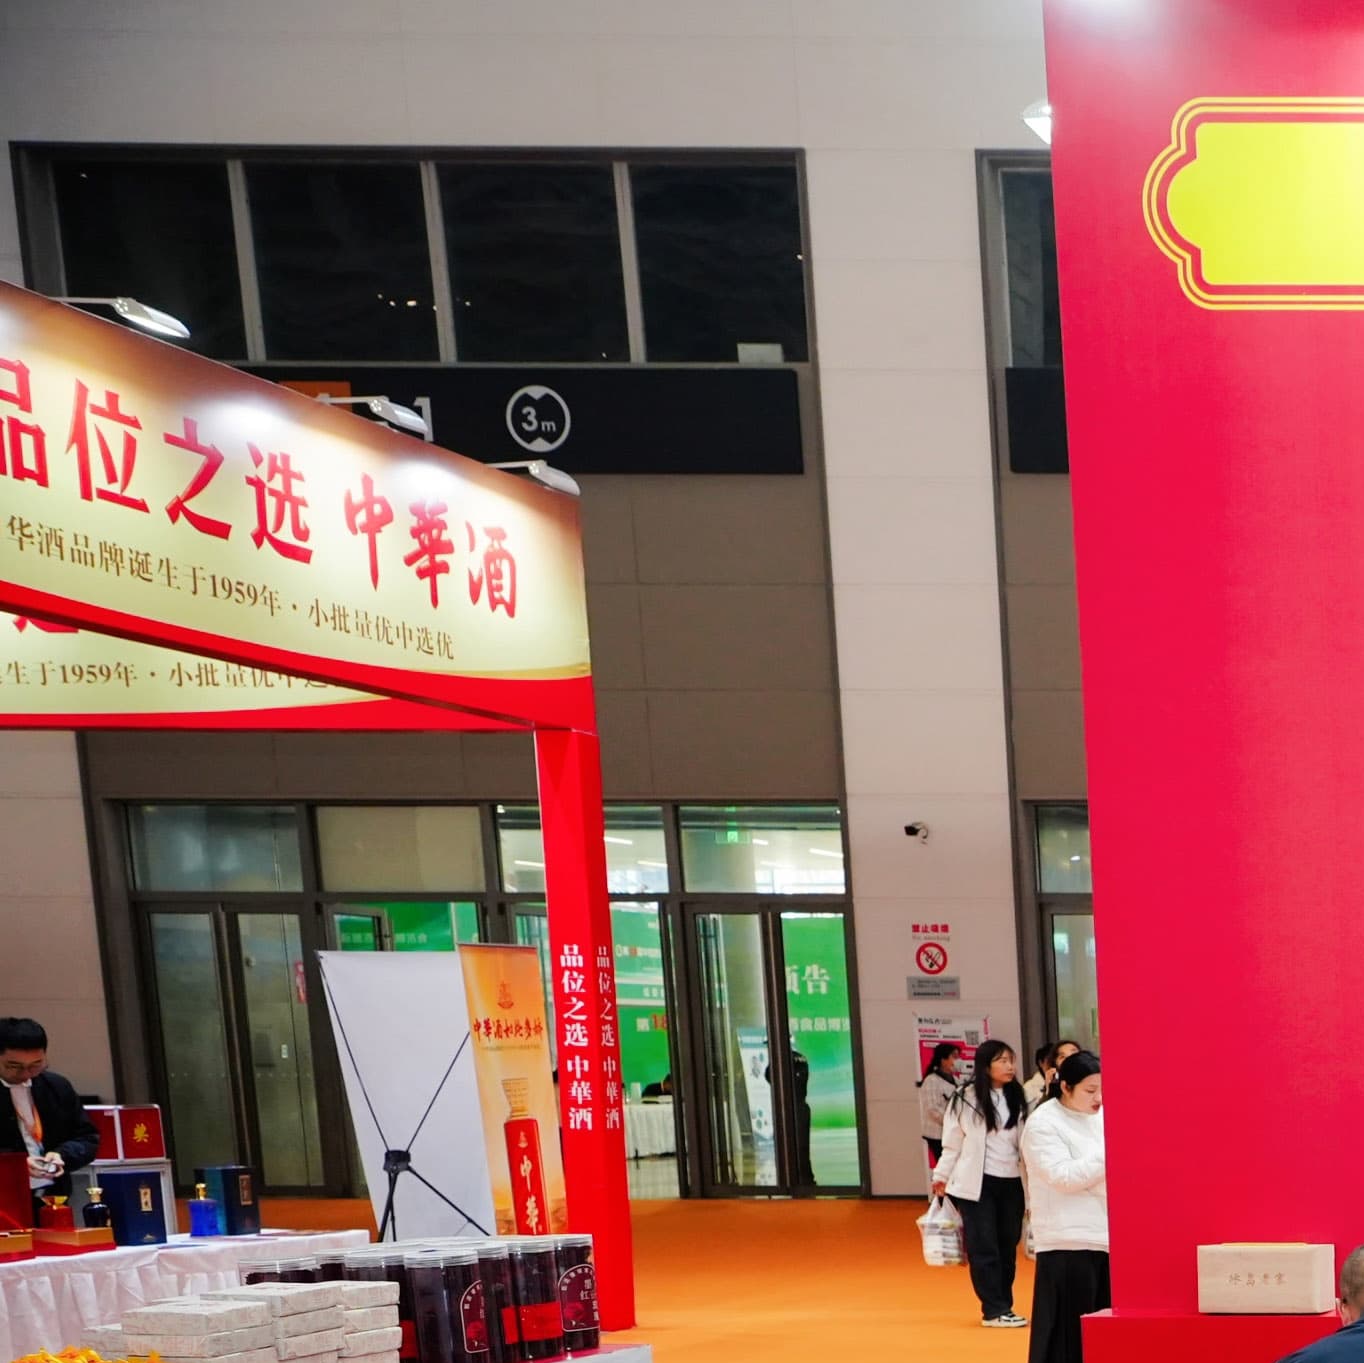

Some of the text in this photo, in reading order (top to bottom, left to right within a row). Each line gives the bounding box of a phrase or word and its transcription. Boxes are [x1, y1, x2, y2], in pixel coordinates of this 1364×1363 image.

[560, 943, 590, 1047] 品位之选
[596, 945, 616, 1047] 品位之选
